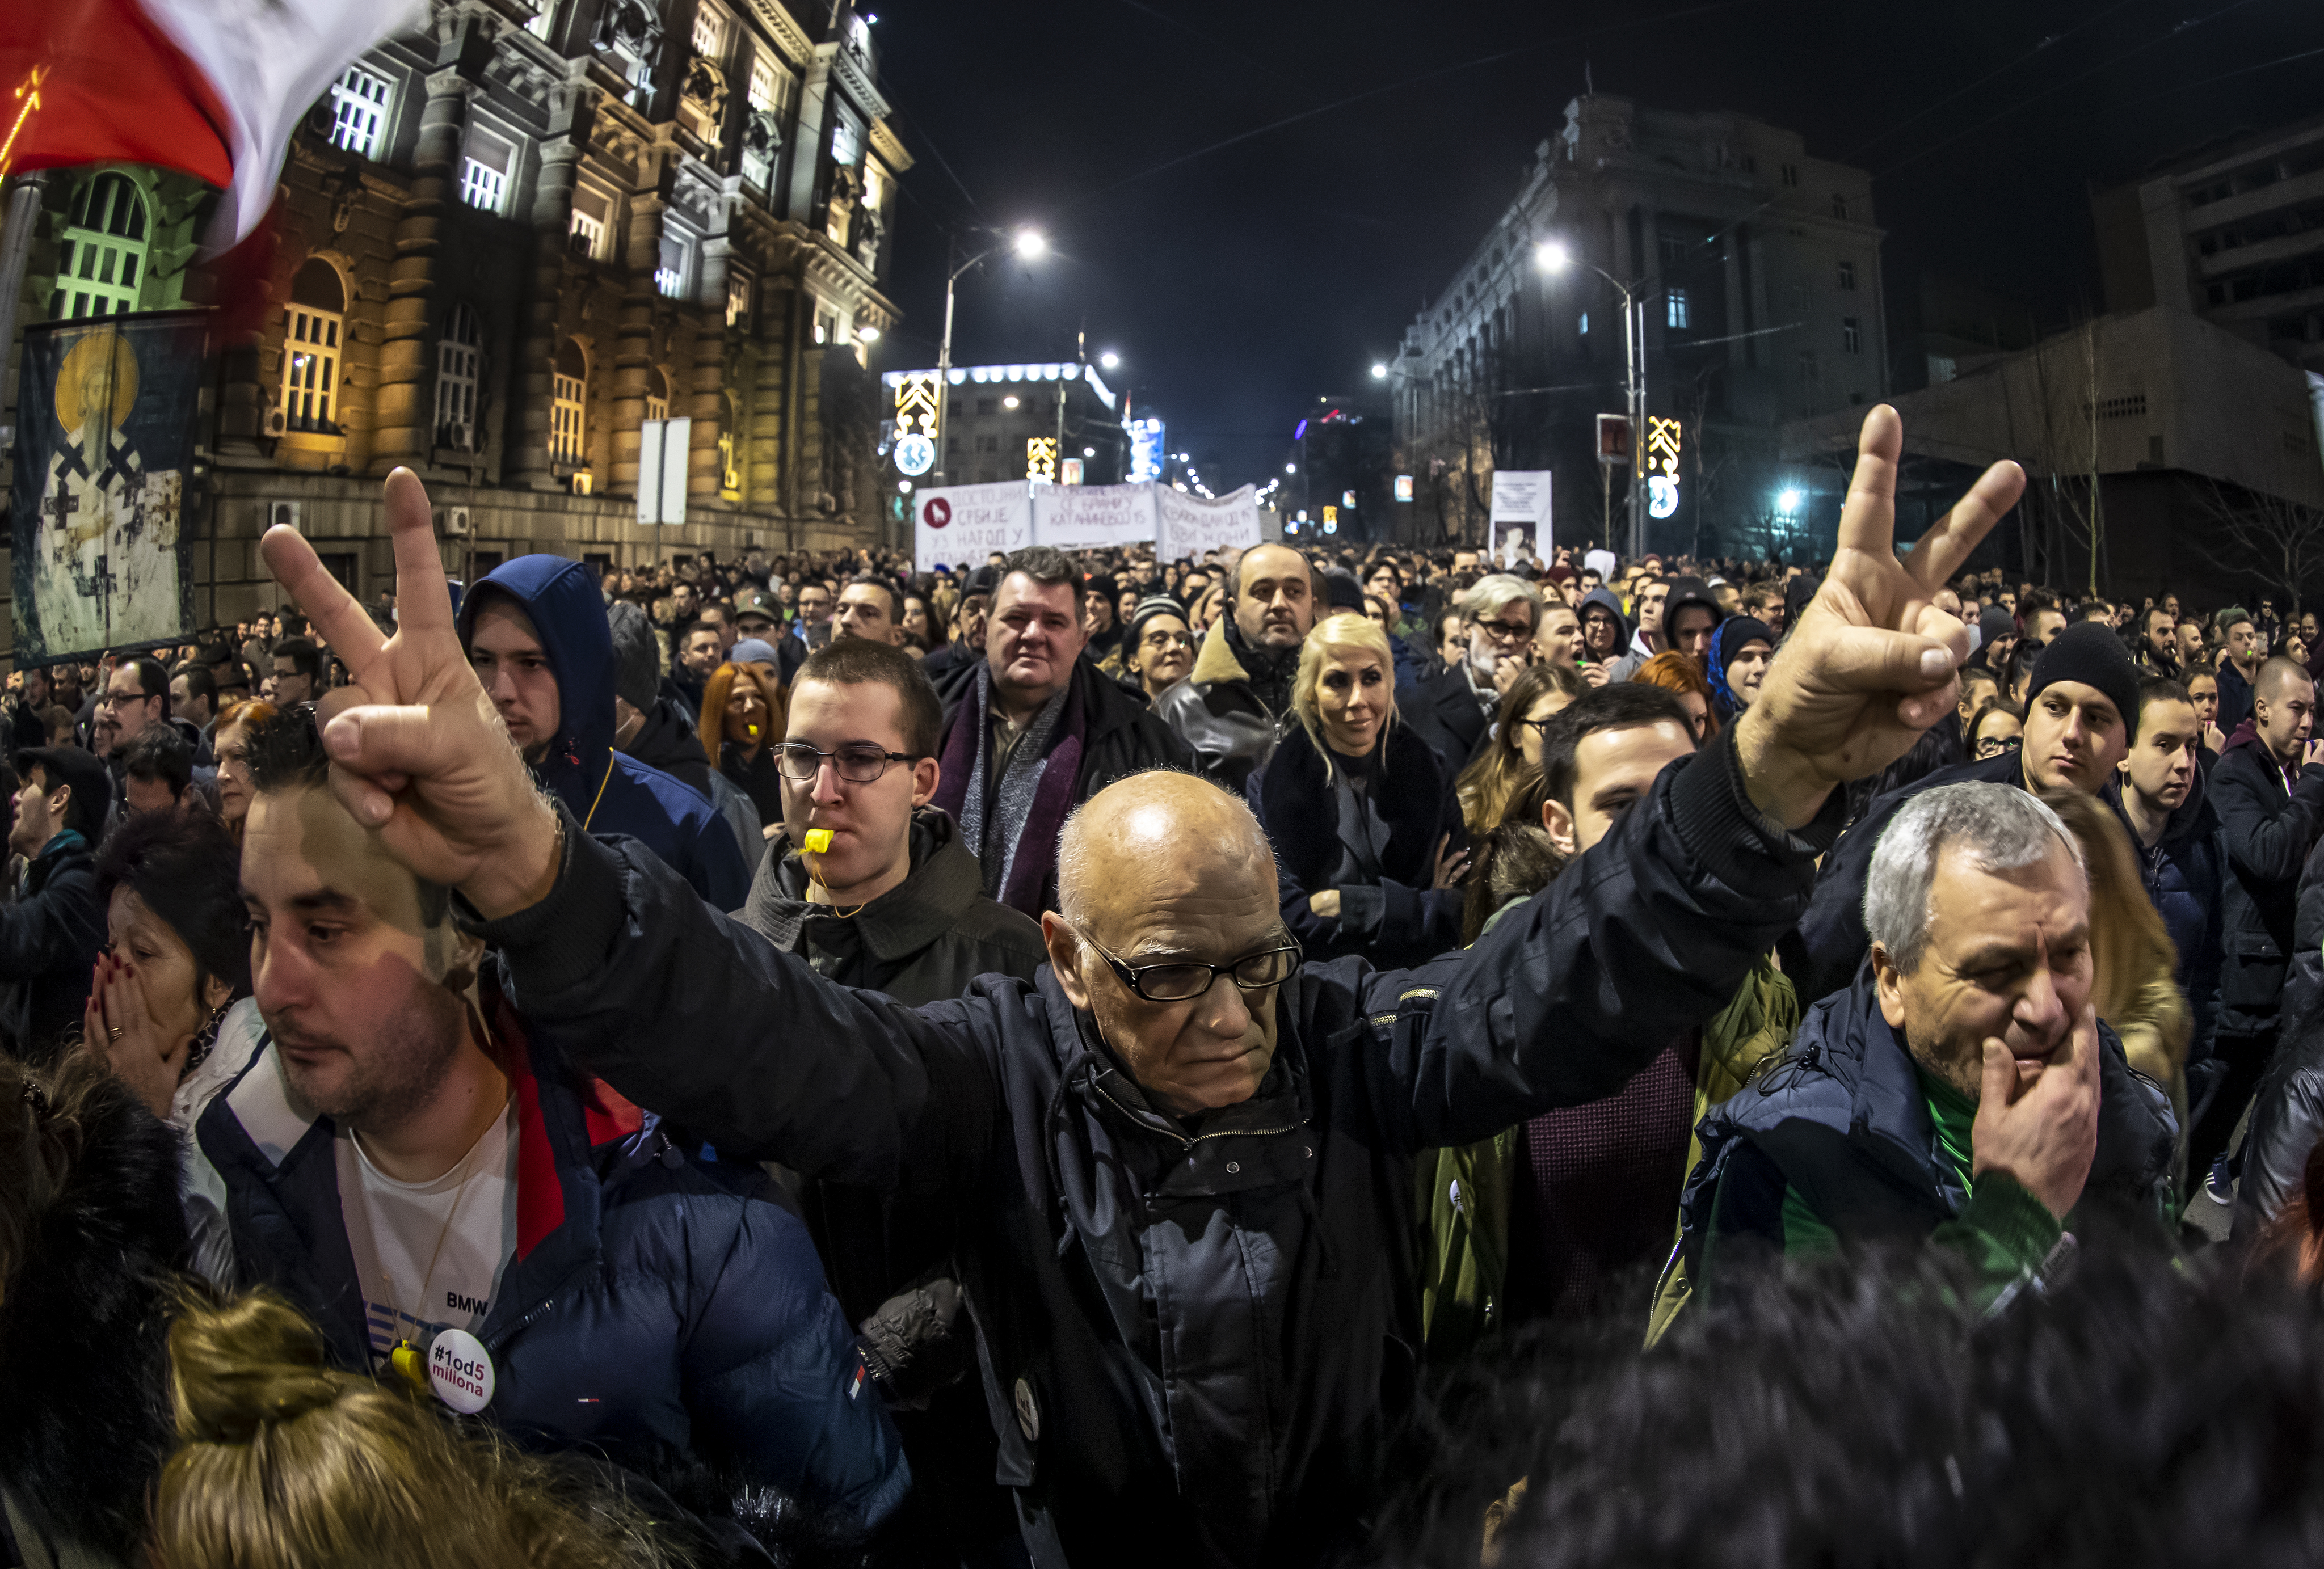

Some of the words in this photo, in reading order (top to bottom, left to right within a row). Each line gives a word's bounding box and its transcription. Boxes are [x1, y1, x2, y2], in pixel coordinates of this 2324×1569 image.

[447, 1291, 488, 1316] BMW
[435, 1344, 485, 1381] #1od5
[432, 1364, 483, 1397] miliona
